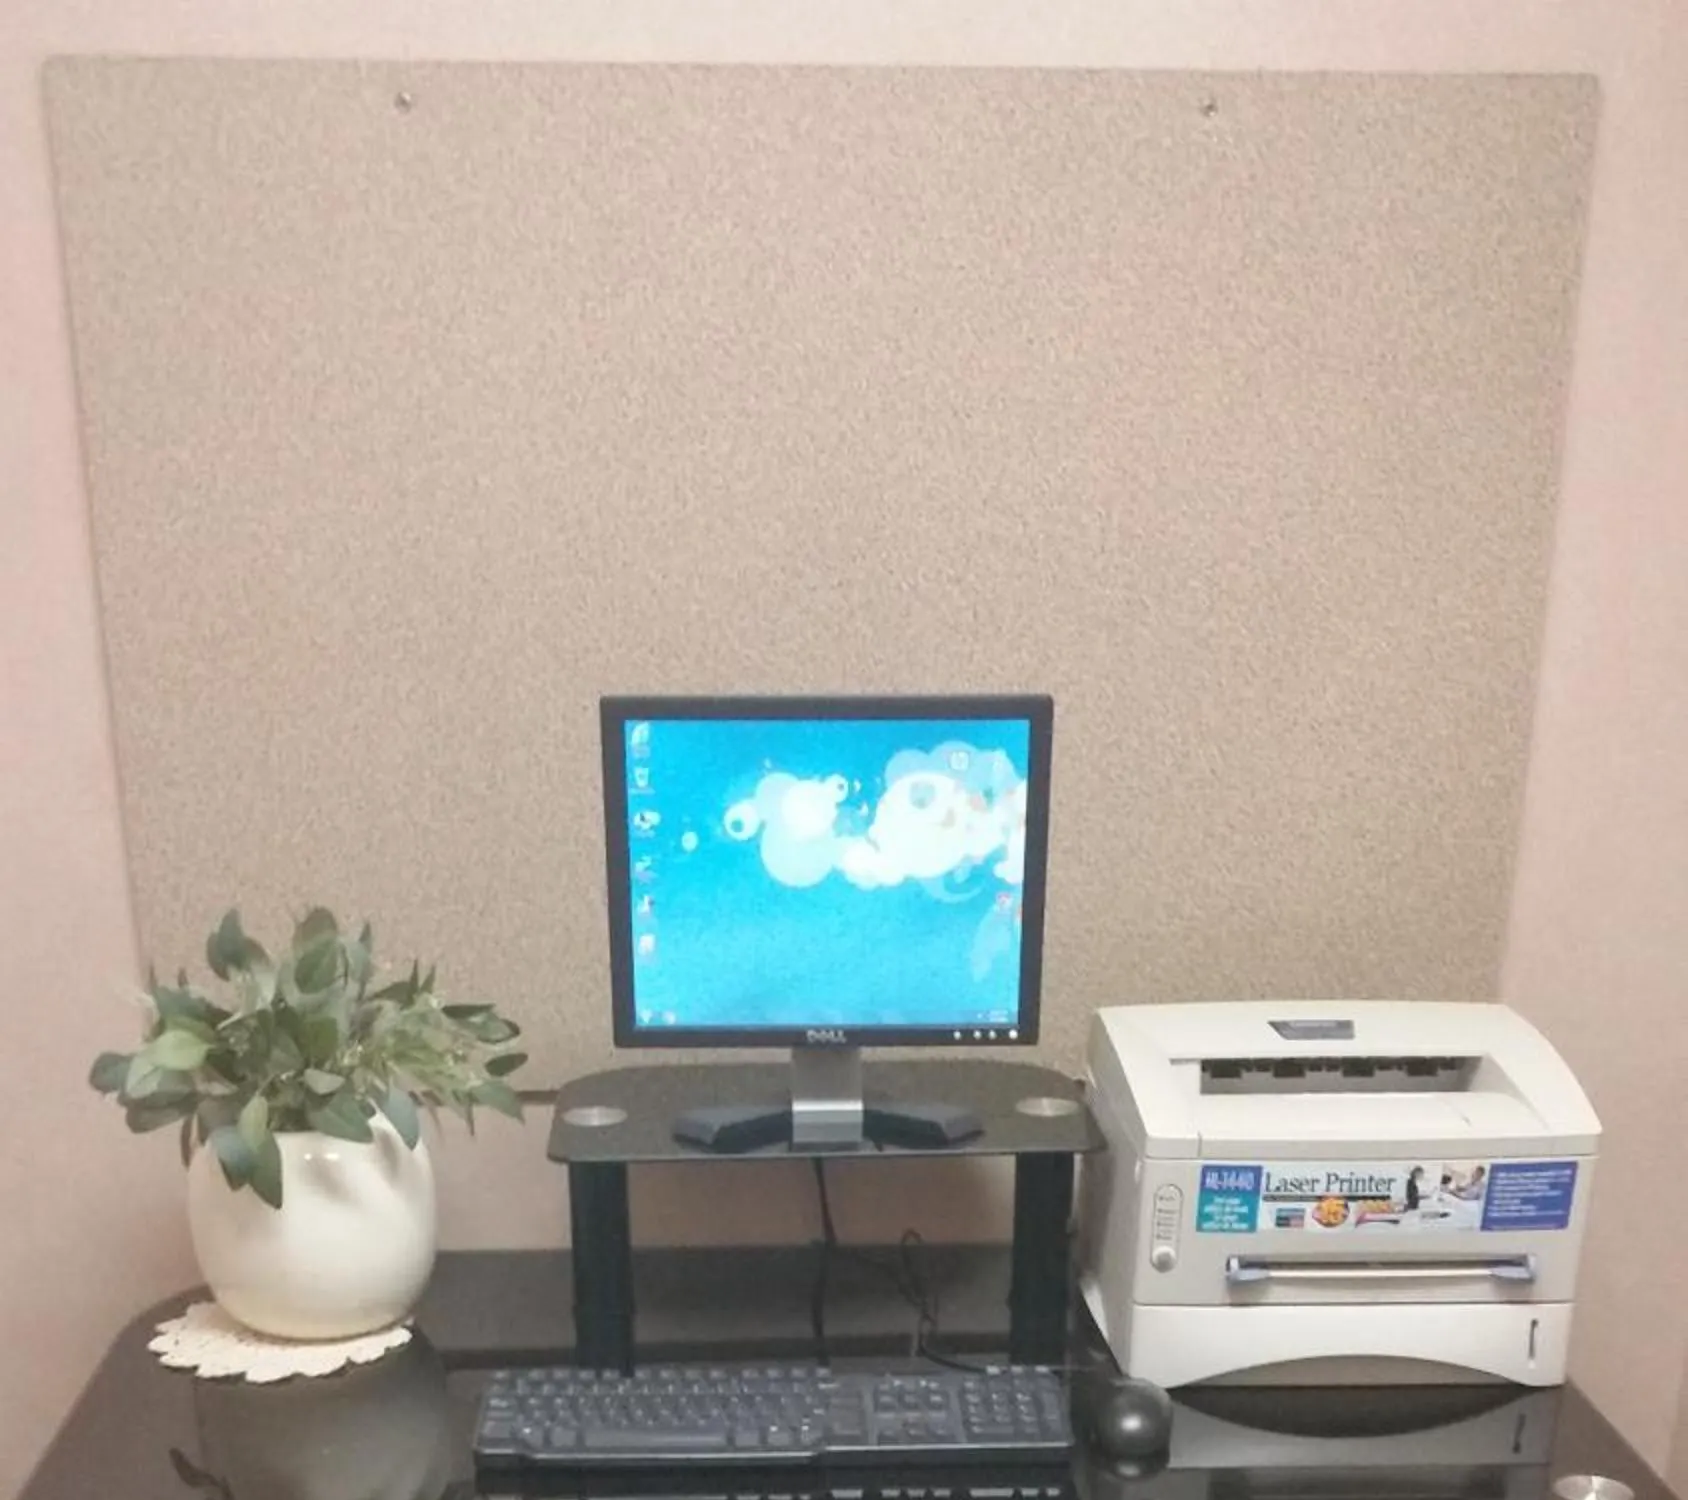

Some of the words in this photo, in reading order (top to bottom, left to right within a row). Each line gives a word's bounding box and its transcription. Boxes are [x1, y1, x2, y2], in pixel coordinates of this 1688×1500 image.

[807, 1029, 847, 1044] DELL
[1265, 1171, 1320, 1193] Laser
[1325, 1171, 1396, 1193] Printer
